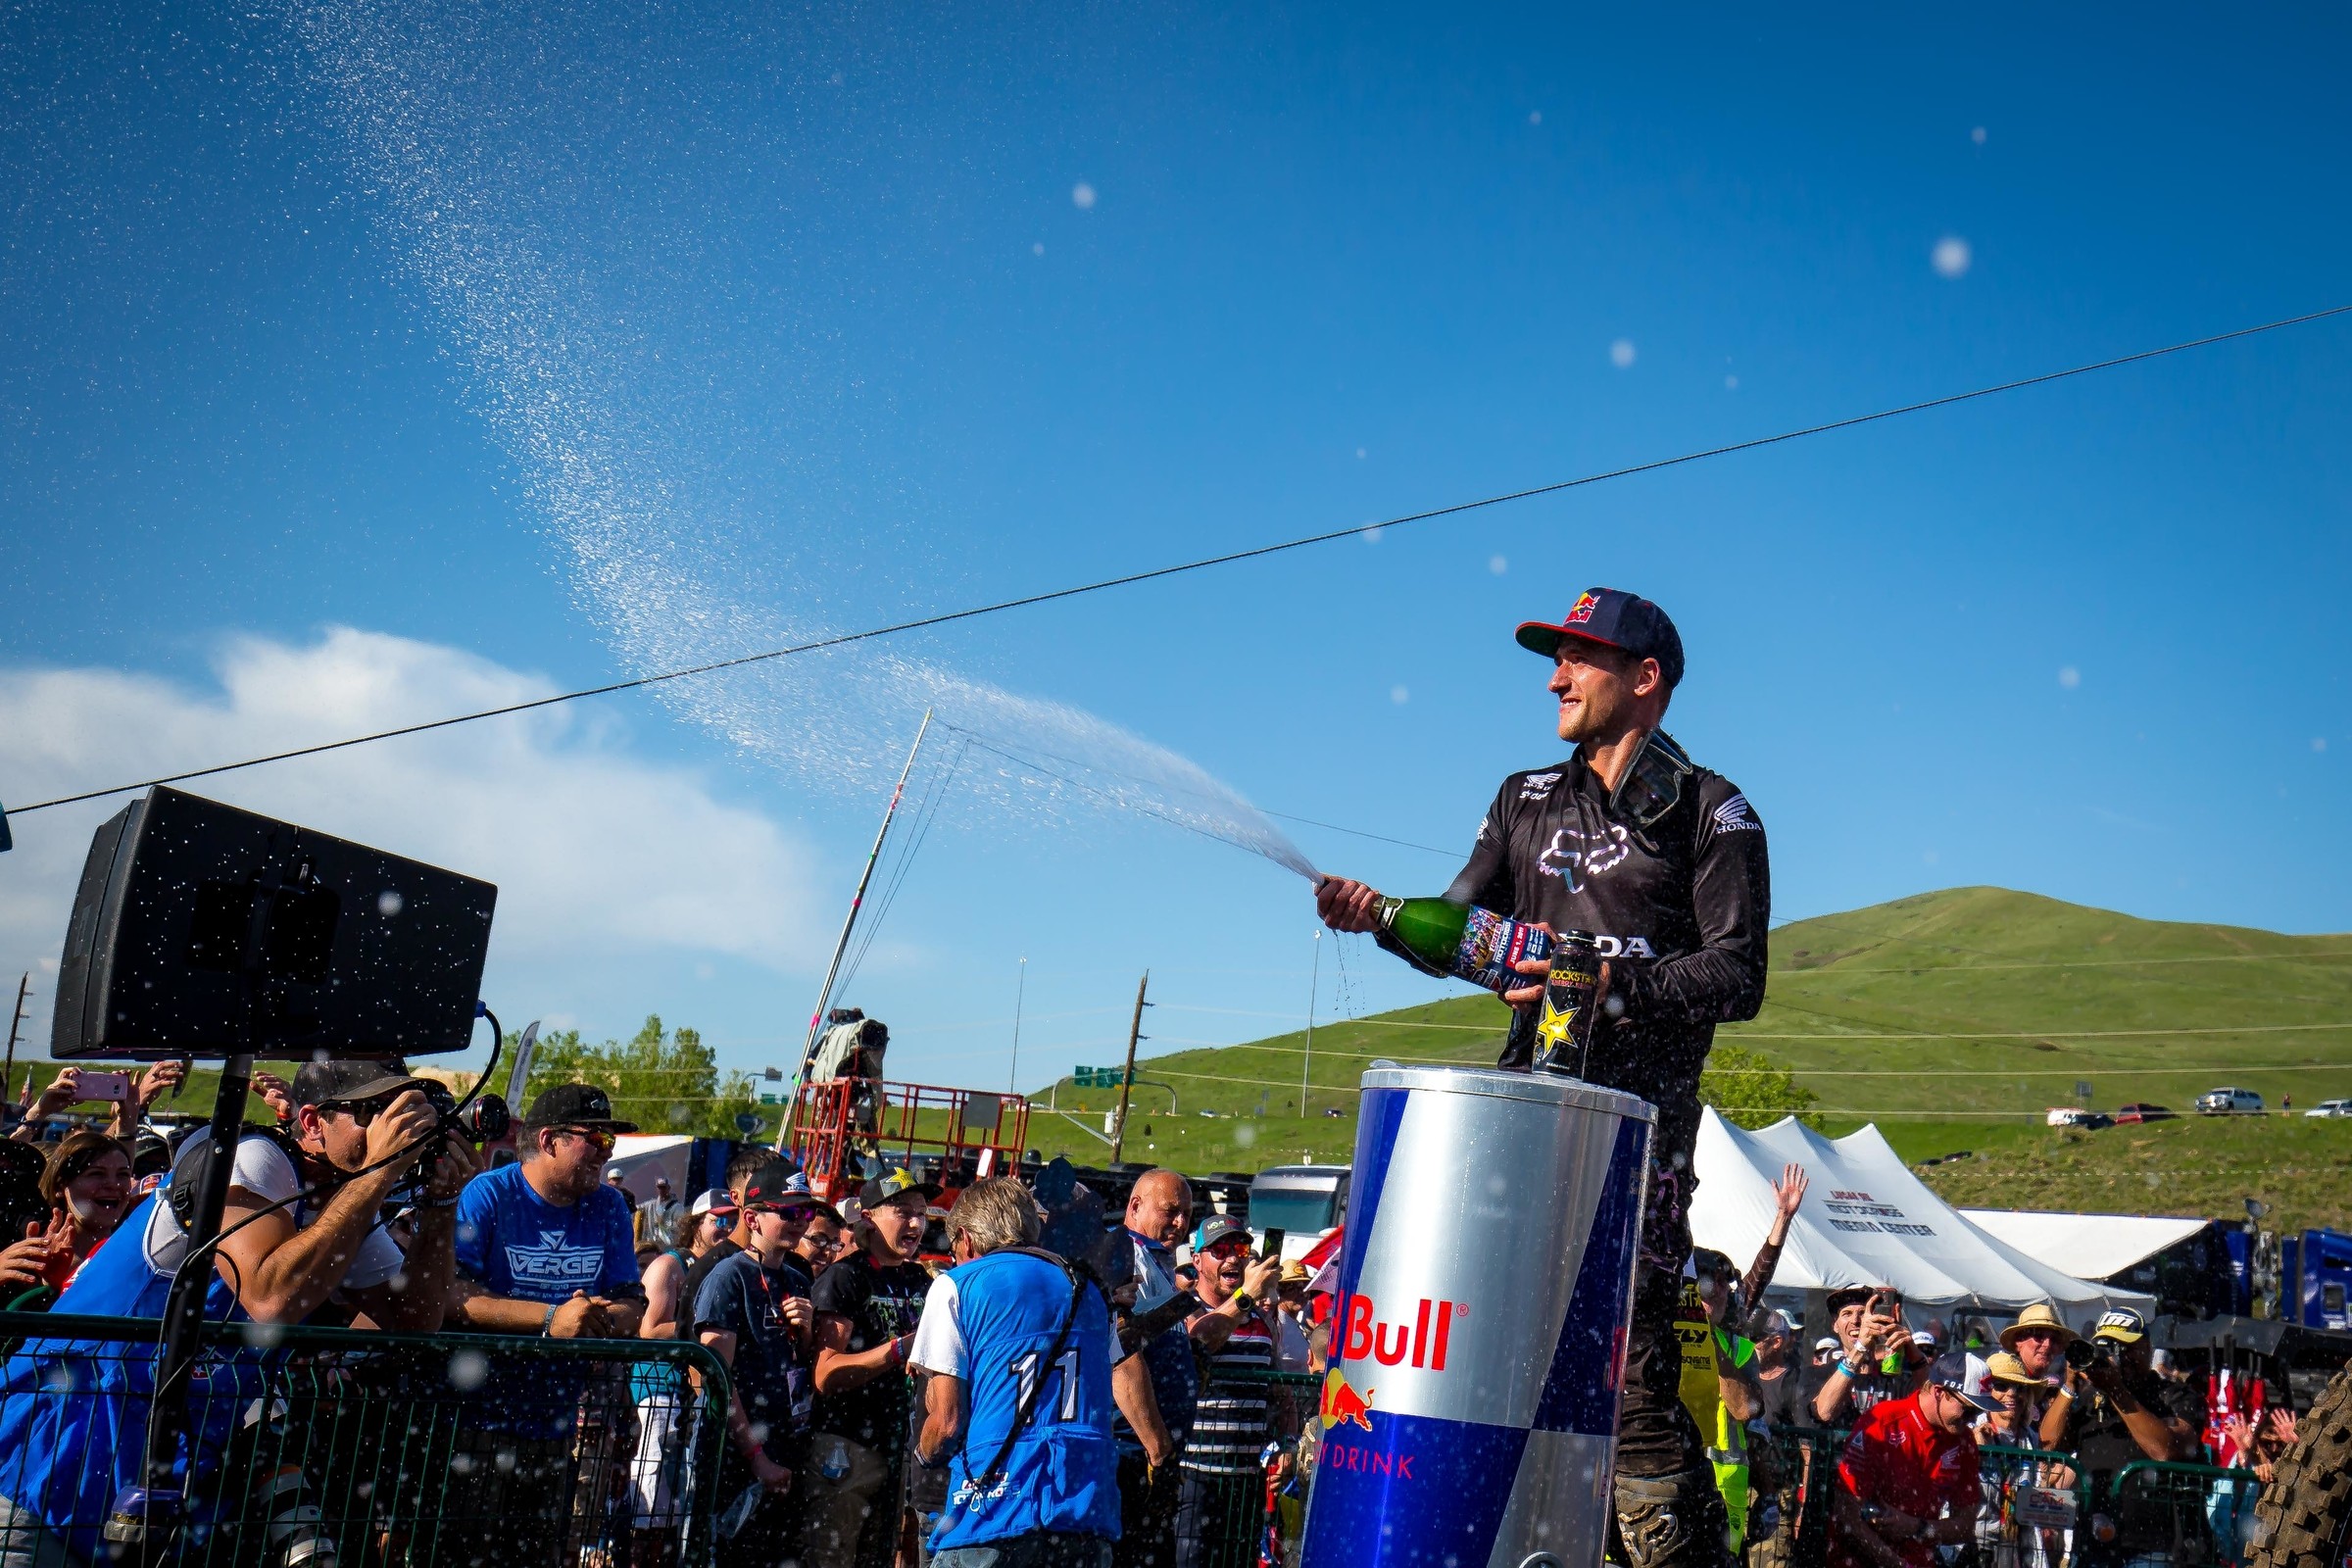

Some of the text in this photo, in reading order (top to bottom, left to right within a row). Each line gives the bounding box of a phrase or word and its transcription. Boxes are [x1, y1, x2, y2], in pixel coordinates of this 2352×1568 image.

[1716, 822, 1762, 834] HONDA
[1494, 921, 1511, 962] MOTOCROSS
[1510, 946, 1520, 964] JUNE
[1550, 969, 1596, 985] ROCKSTAR
[1828, 1219, 1937, 1236] MEDIA CENTER
[511, 1253, 601, 1275] VERGE
[1343, 1294, 1452, 1371] Bull
[1009, 1349, 1079, 1423] 11
[1943, 1380, 1964, 1390] FOX
[1333, 1445, 1415, 1480] DRINK
